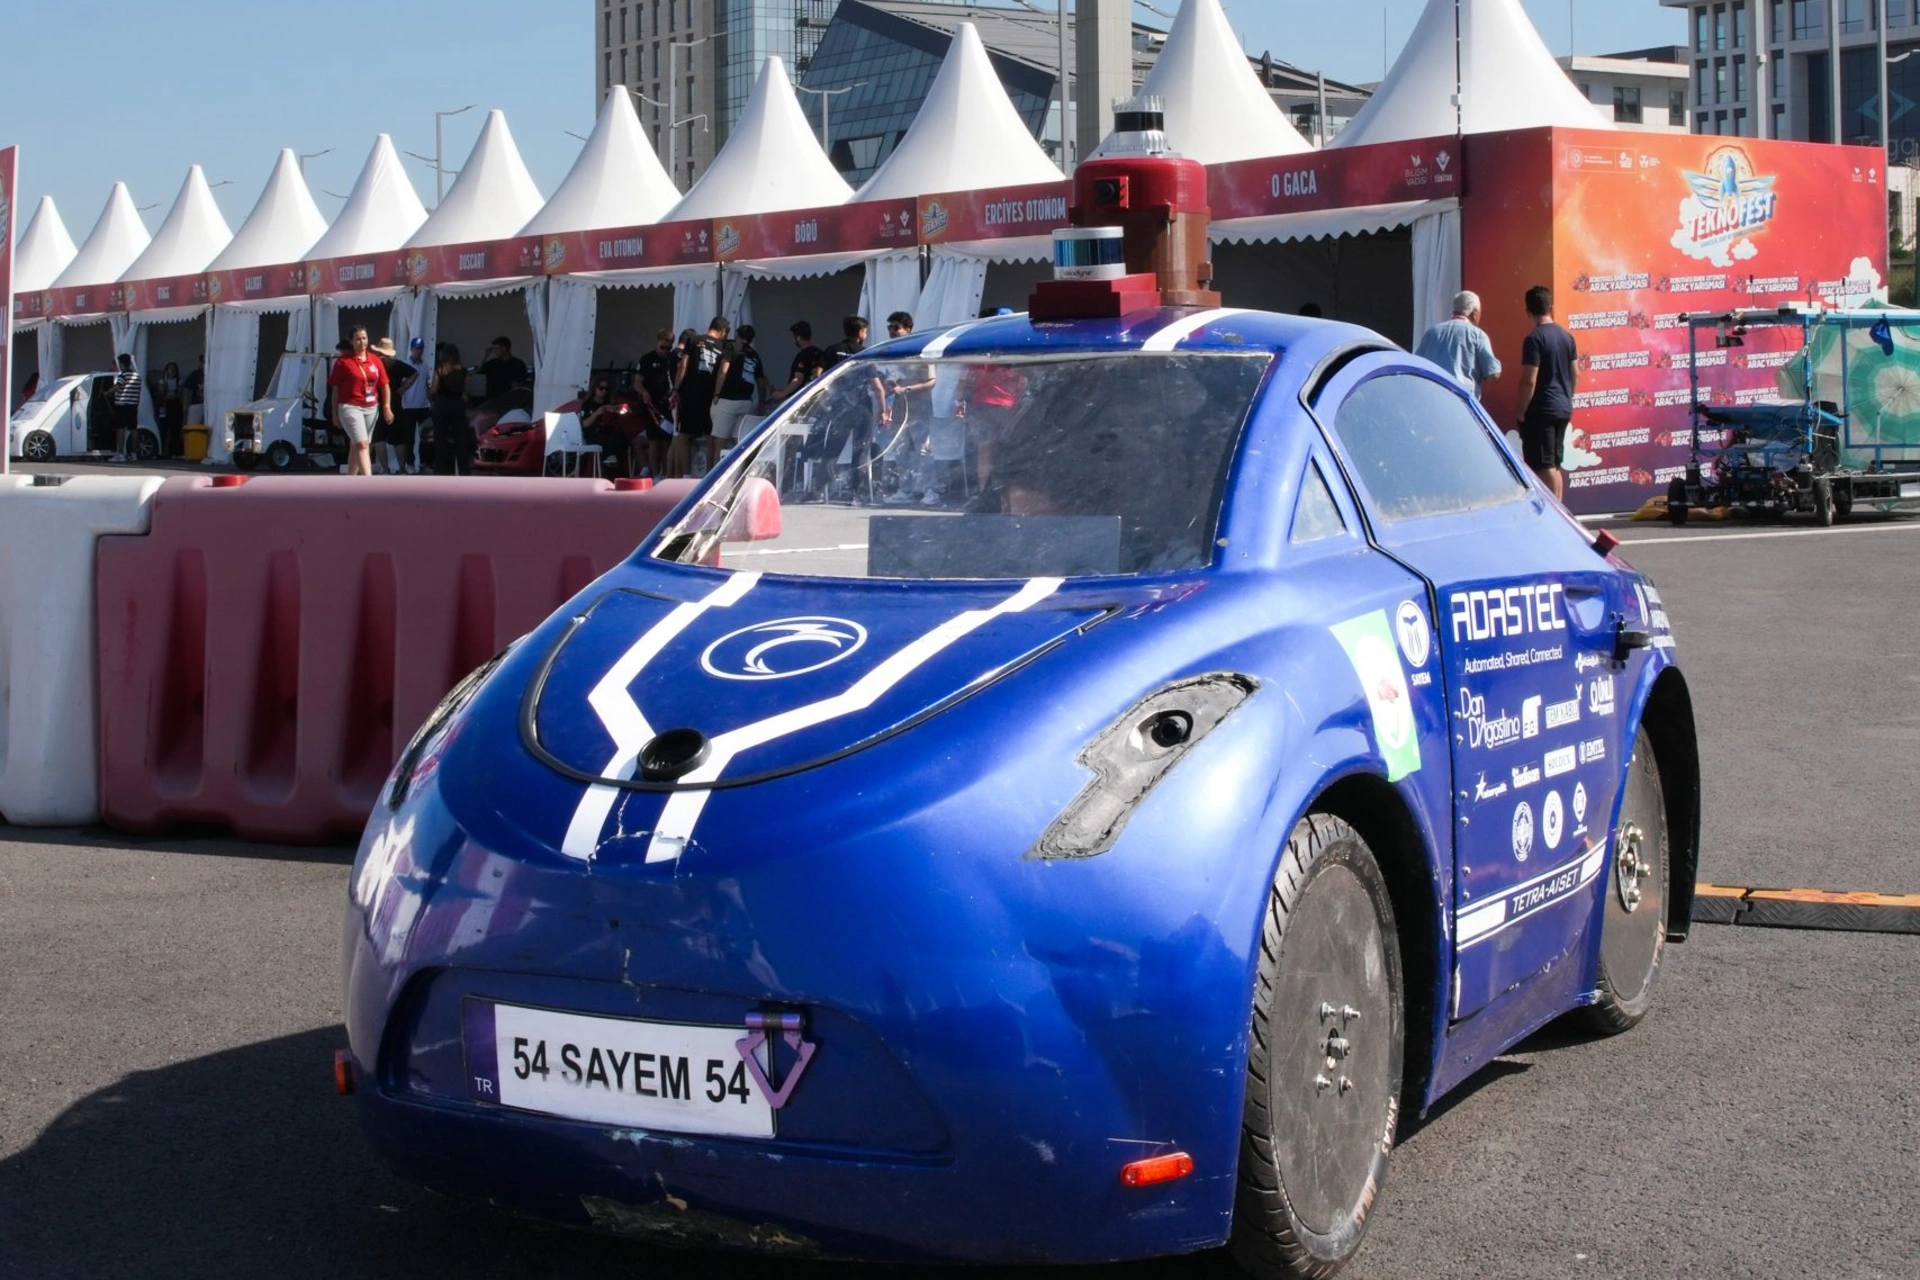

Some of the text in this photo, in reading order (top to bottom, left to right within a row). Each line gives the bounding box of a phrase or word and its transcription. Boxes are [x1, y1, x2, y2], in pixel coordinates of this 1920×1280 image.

[1284, 170, 1317, 196] GACA
[985, 198, 1023, 224] ERCİYES
[1689, 192, 1776, 241] TEKNOFEST
[794, 218, 818, 244] BÖRÜ
[599, 240, 612, 258] EVA
[1450, 584, 1566, 642] ADASTEC
[1465, 654, 1505, 674] Automated,
[1505, 650, 1530, 668] Shared,
[1530, 645, 1562, 663] Connected
[1460, 687, 1485, 718] Dan
[1512, 868, 1579, 914] TETRA-AISET
[514, 1036, 750, 1104] 54 SAYEM 54
[474, 1076, 493, 1094] TR
